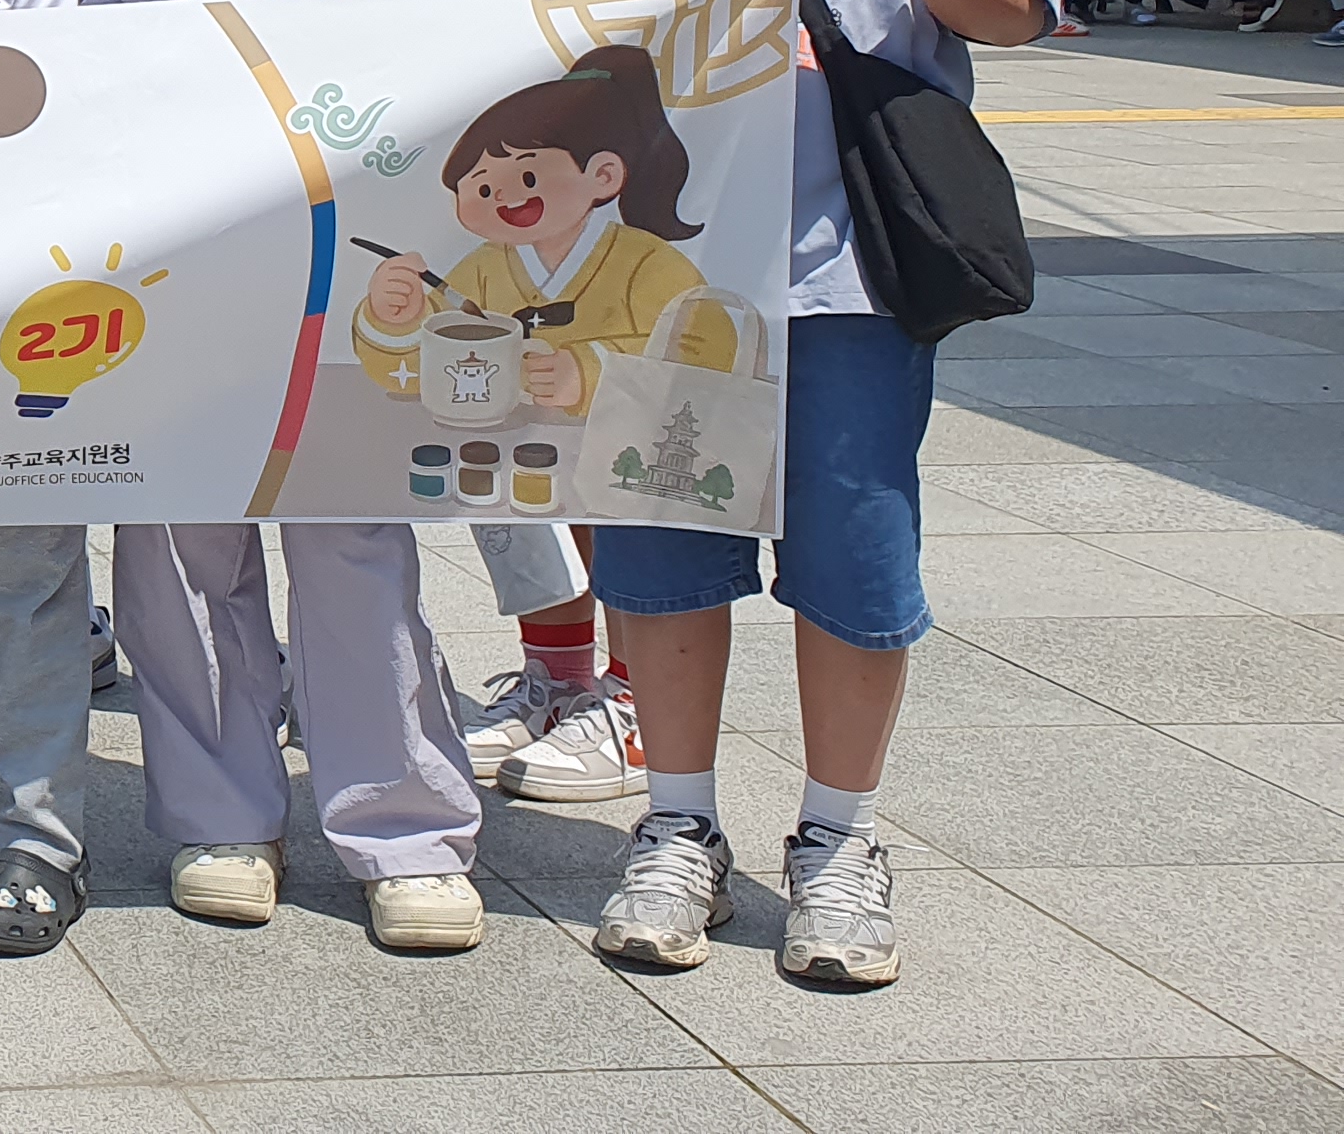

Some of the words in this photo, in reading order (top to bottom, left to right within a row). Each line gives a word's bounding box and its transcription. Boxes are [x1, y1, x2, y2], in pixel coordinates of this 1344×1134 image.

[16, 308, 125, 362] 2기
[48, 473, 65, 485] OF
[71, 471, 145, 484] EDUCATION
